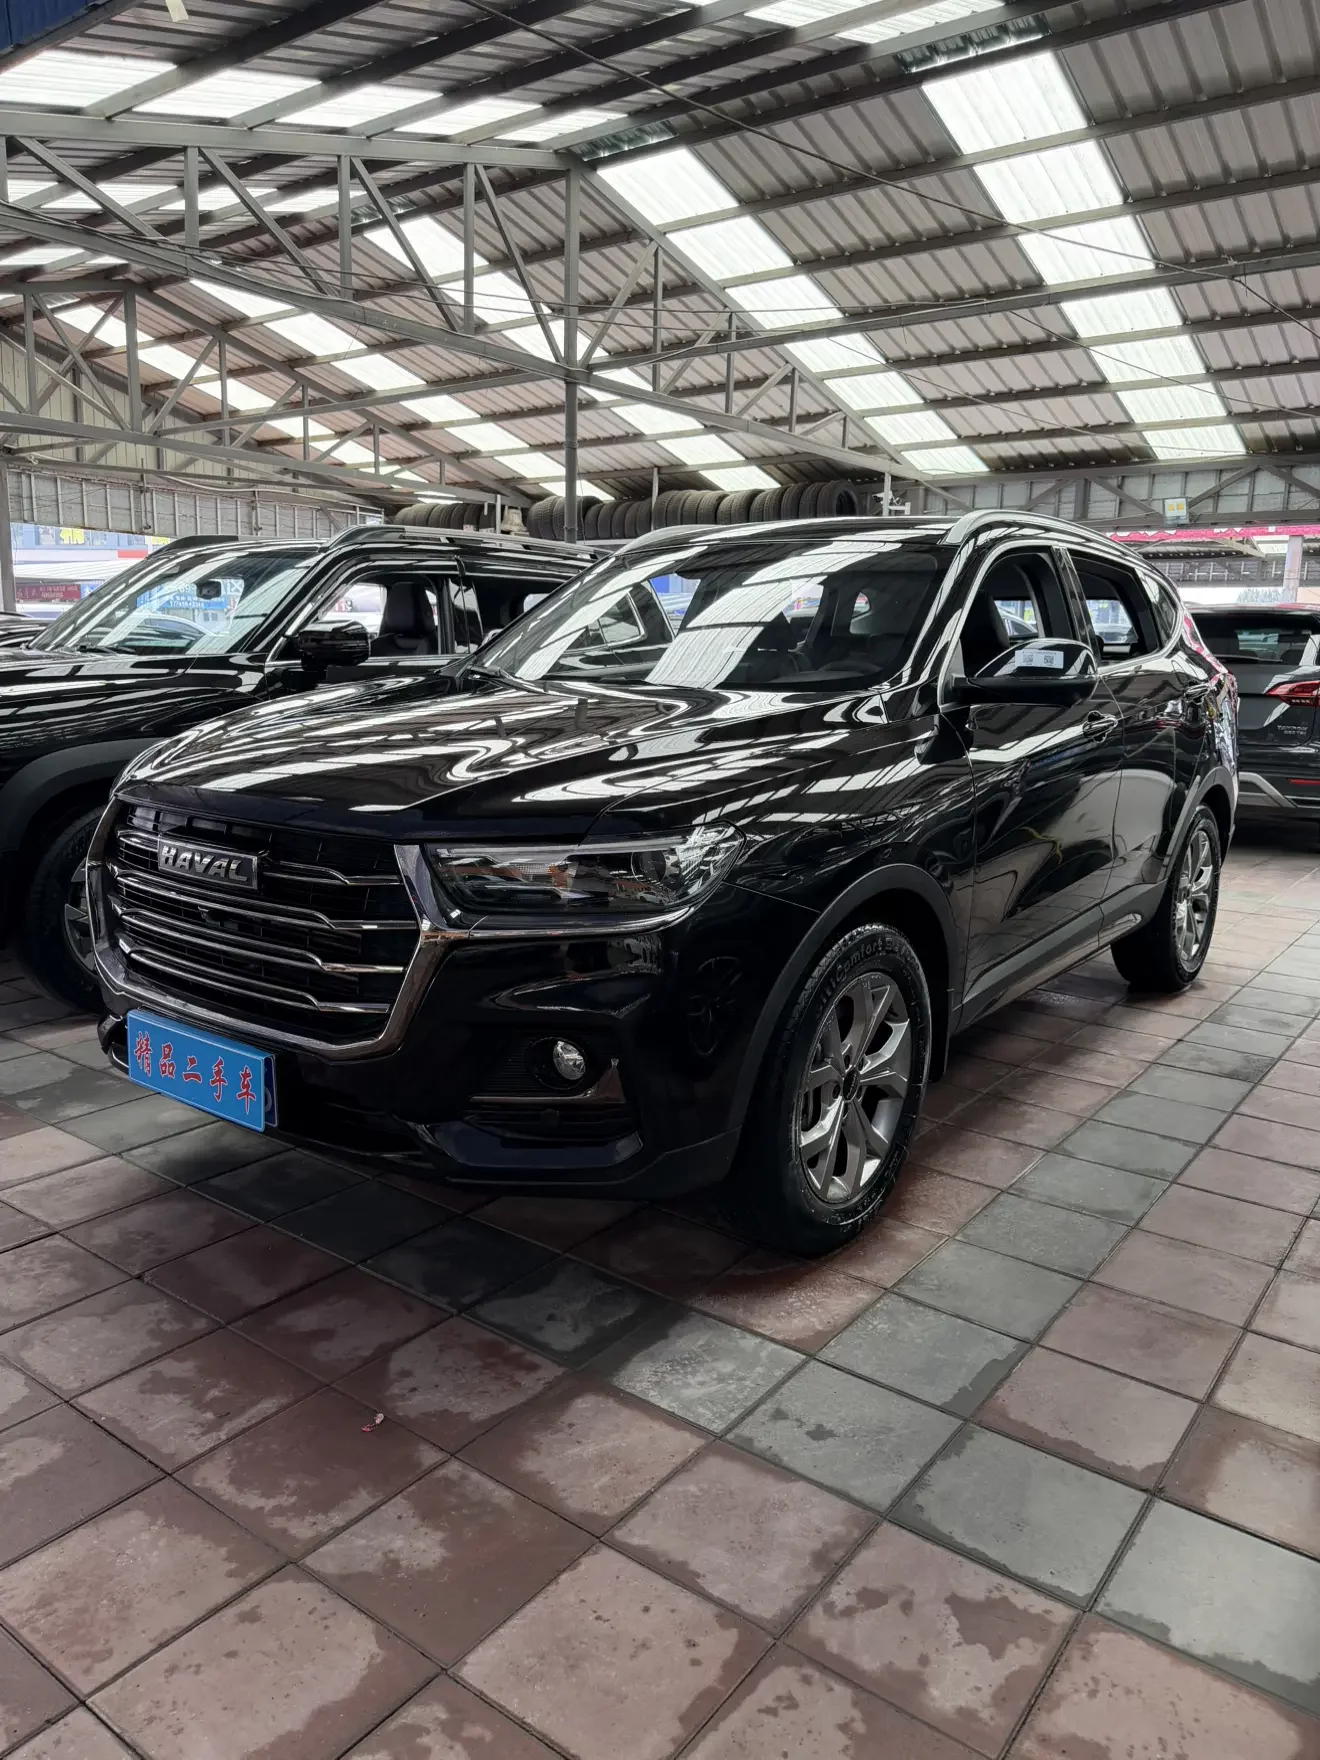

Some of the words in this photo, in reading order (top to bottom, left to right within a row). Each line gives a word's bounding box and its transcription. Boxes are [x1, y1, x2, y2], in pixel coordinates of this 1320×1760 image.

[161, 845, 248, 882] HAVAL
[134, 1032, 256, 1115] 精品二手车
